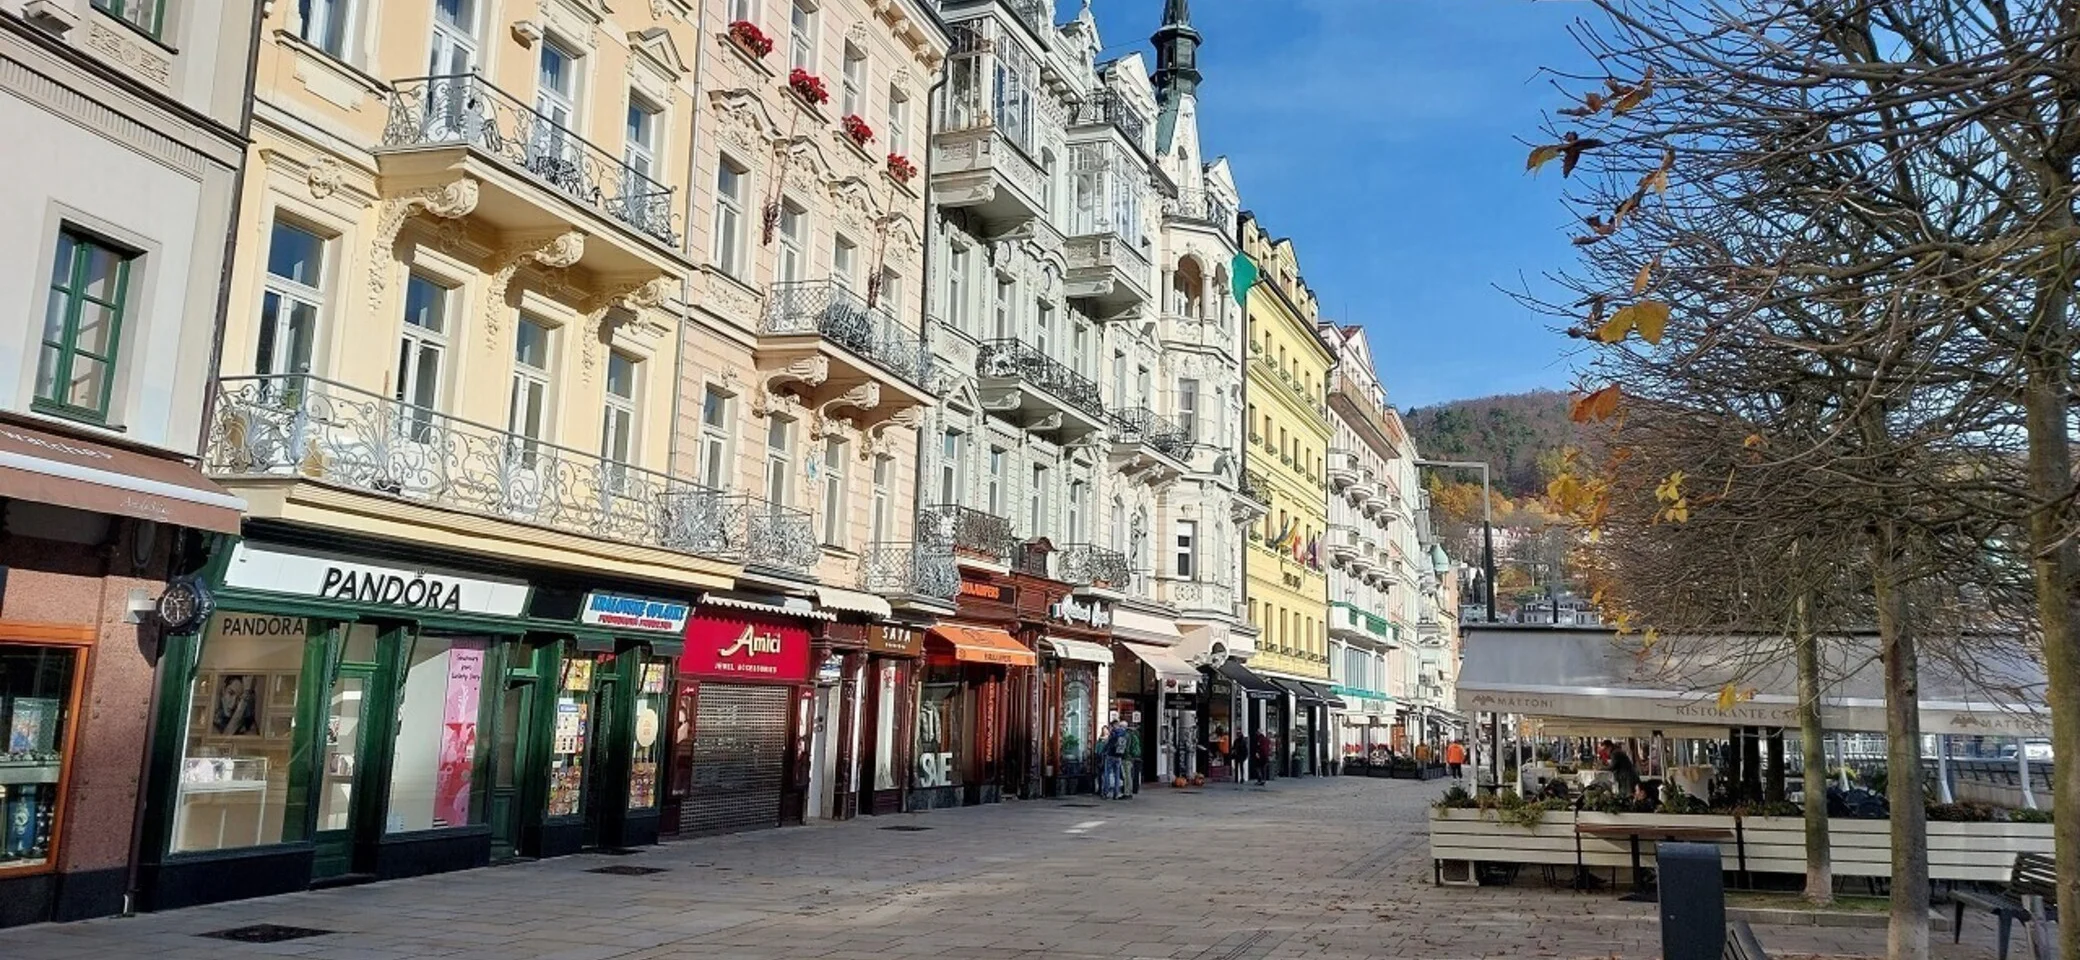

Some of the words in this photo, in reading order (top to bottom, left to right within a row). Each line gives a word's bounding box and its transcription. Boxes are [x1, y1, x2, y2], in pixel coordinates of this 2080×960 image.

[320, 567, 461, 611] PANDORA
[221, 617, 305, 636] PANDORA
[718, 624, 781, 657] Amici
[1497, 696, 1553, 708] MATTONI
[1676, 705, 1766, 720] RISTORANTE
